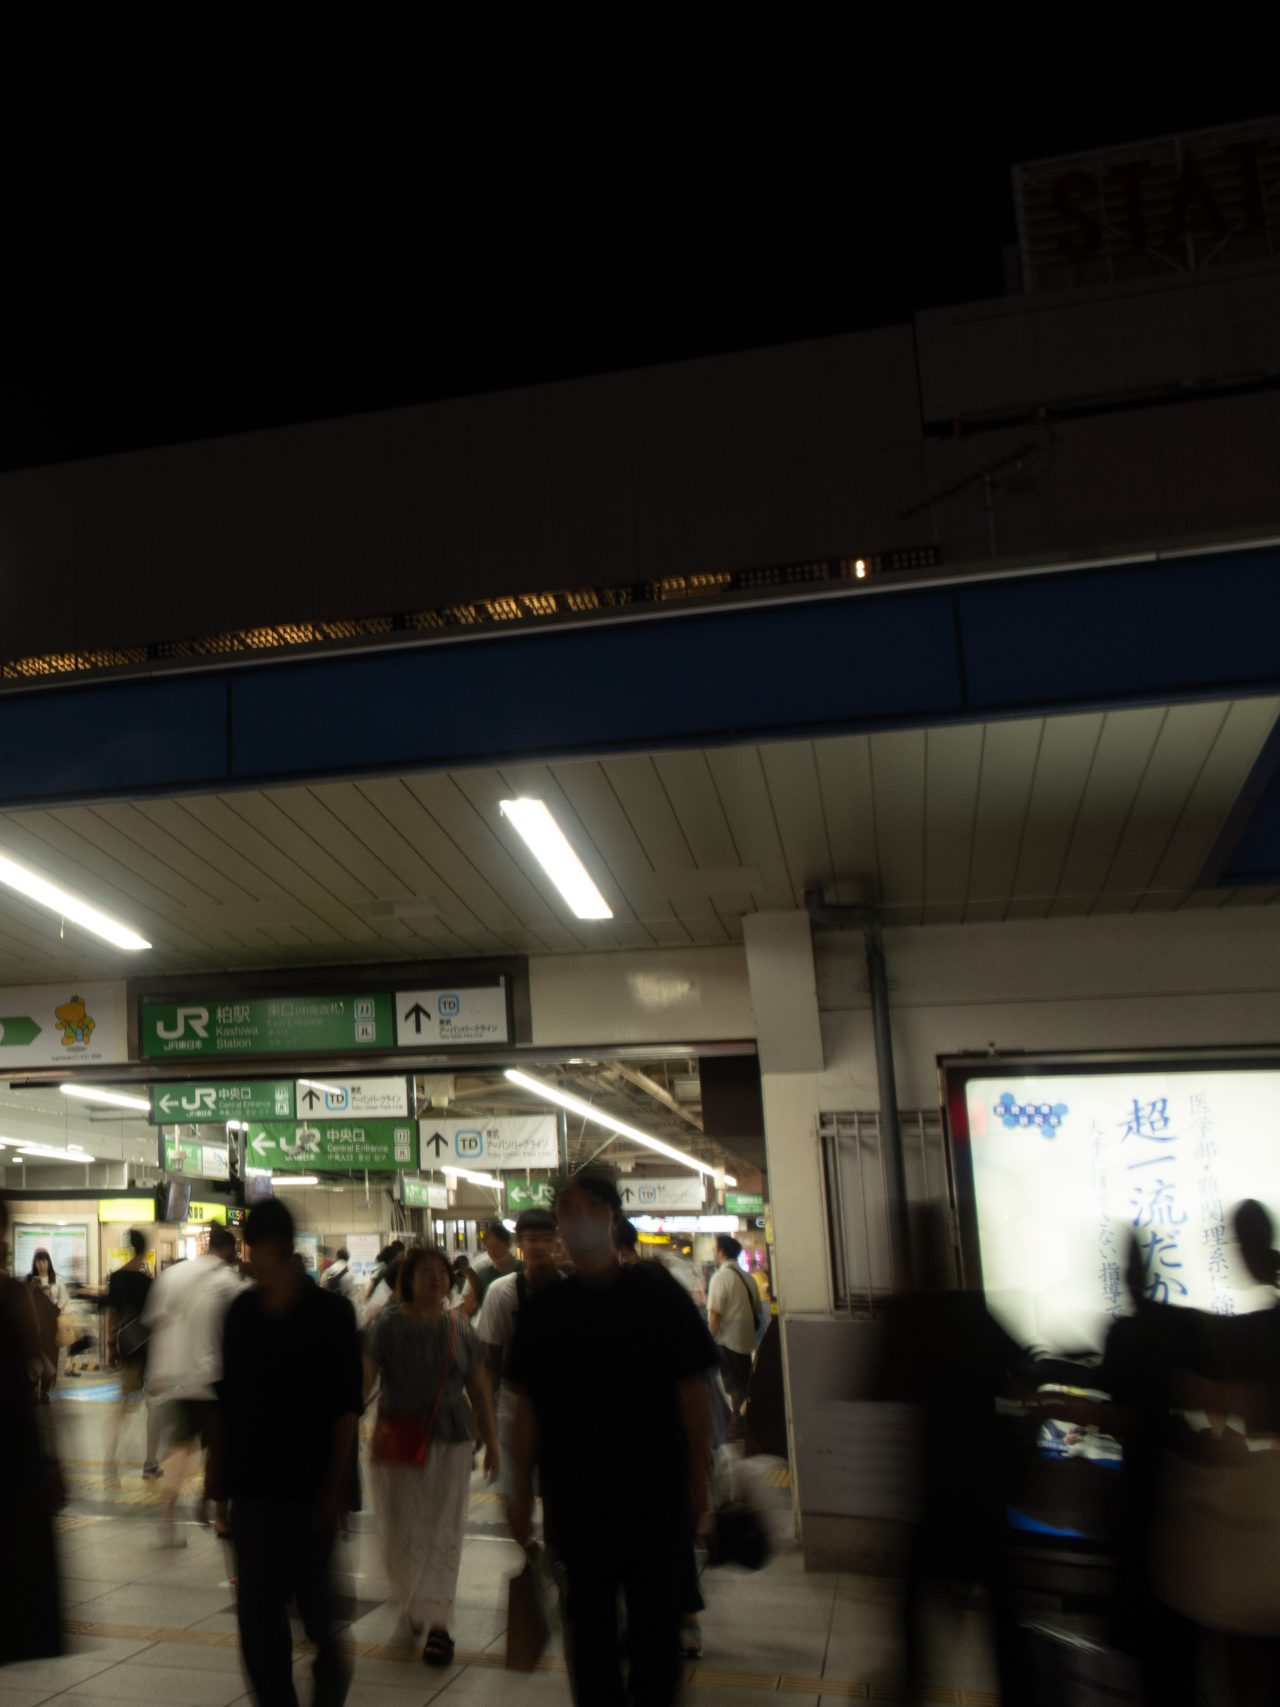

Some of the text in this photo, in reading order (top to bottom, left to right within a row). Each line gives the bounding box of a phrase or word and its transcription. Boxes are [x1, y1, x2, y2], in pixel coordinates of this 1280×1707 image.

[442, 1000, 456, 1011] TD
[215, 1005, 252, 1024] 柏駅
[156, 1006, 210, 1040] JR
[215, 1023, 259, 1037] Kashiwa
[163, 1039, 203, 1051] JR東日本
[215, 1038, 252, 1049] Station
[181, 1087, 217, 1110] JR
[218, 1087, 252, 1101] 中央口
[330, 1094, 345, 1105] TD
[326, 1128, 365, 1143] 中央口
[327, 1144, 389, 1153] Central Entrance
[461, 1138, 478, 1151] TD
